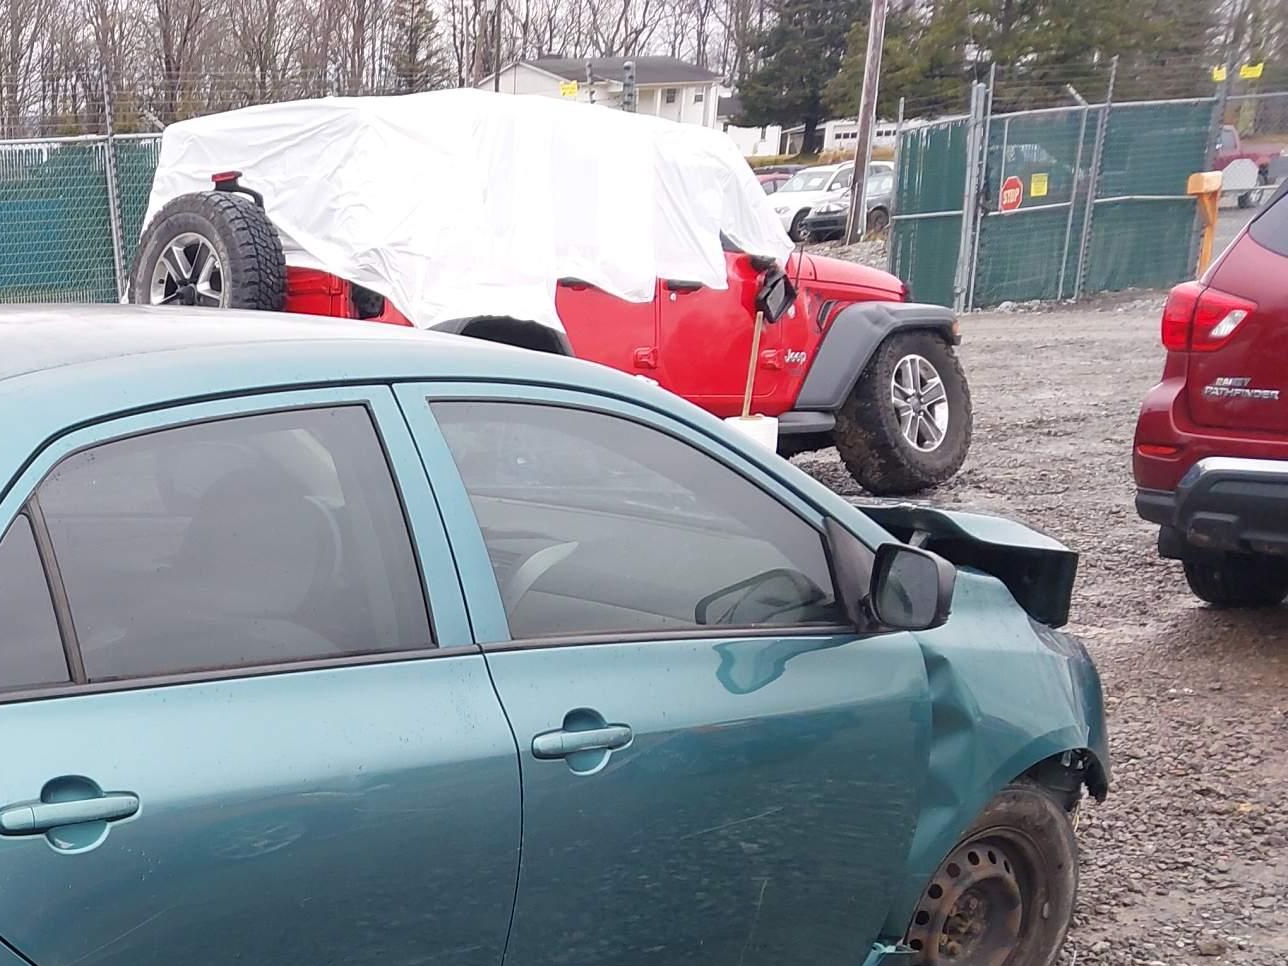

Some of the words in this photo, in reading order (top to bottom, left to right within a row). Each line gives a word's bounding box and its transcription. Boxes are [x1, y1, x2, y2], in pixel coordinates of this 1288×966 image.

[1003, 187, 1020, 204] STOP
[784, 348, 807, 365] Jeep
[1204, 386, 1281, 400] PATHFINDER
